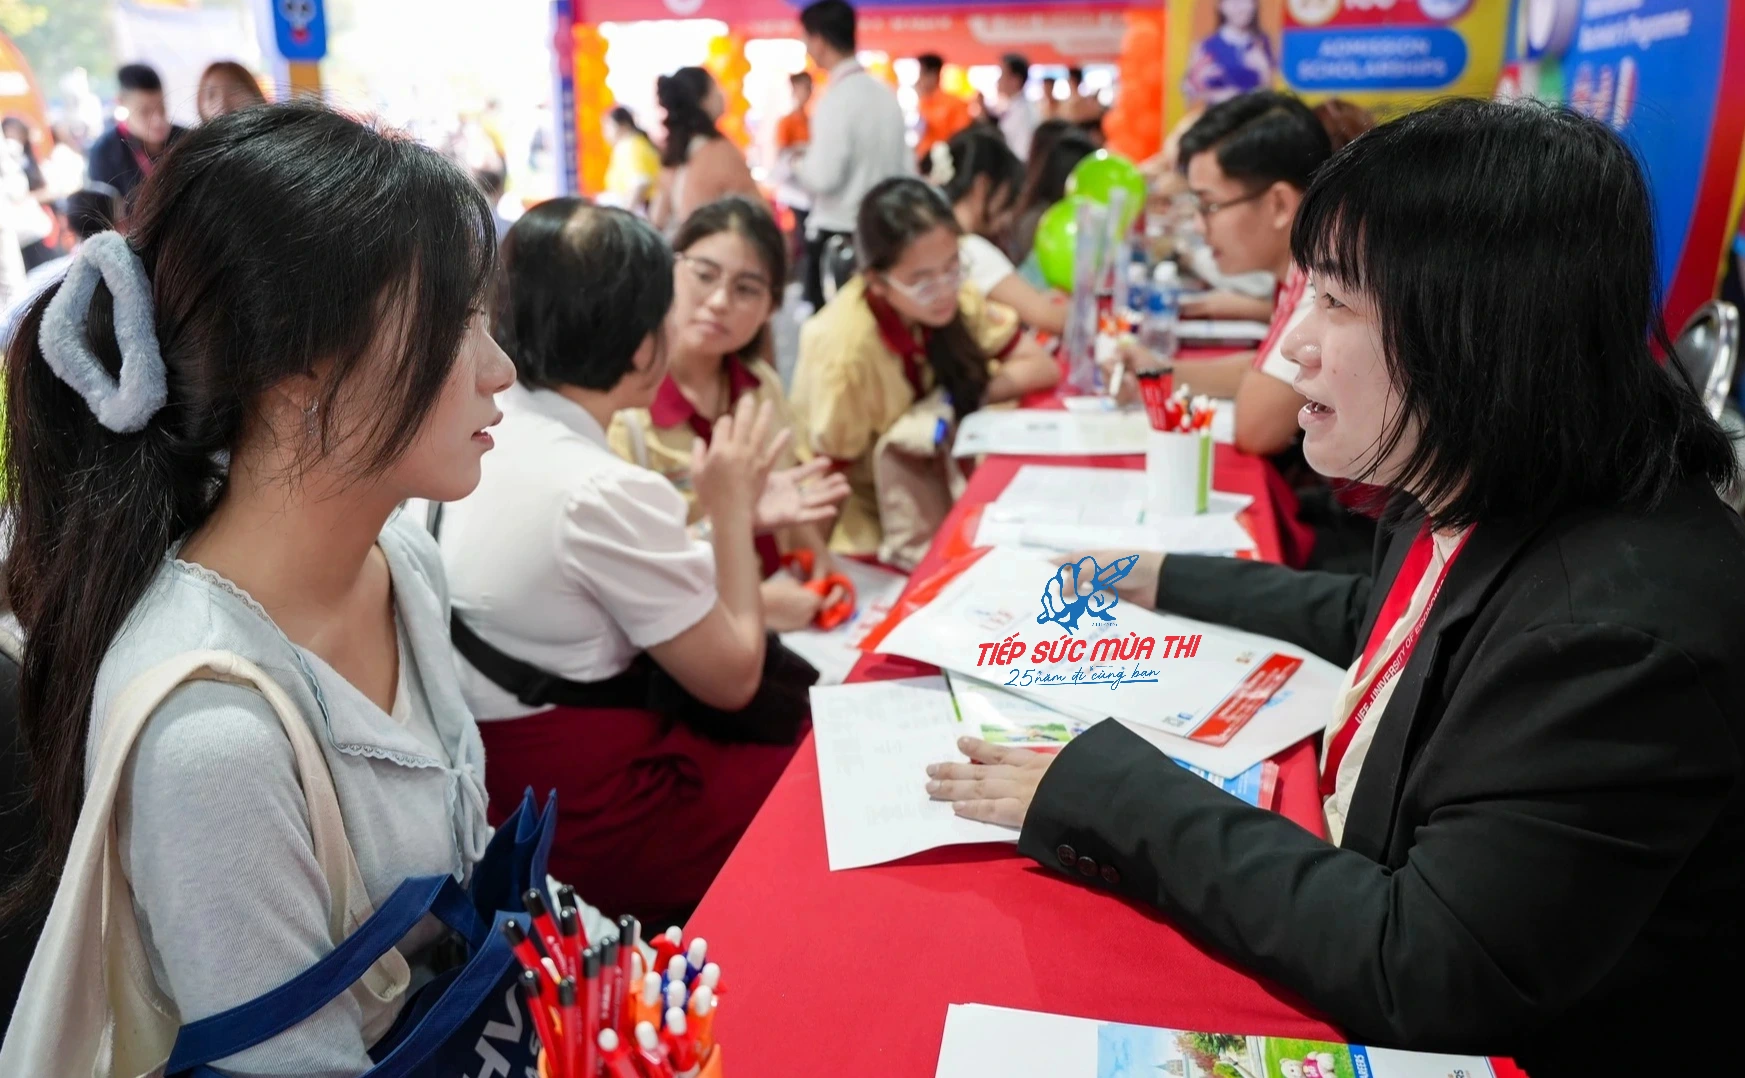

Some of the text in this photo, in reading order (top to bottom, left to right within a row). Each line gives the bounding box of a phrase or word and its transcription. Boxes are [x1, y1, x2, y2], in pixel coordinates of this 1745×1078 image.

[1319, 36, 1431, 57] ADMISSION
[1297, 58, 1447, 80] SCHOLARSHIPS
[1370, 646, 1407, 701] UNIVERSITY
[1405, 632, 1414, 649] OF
